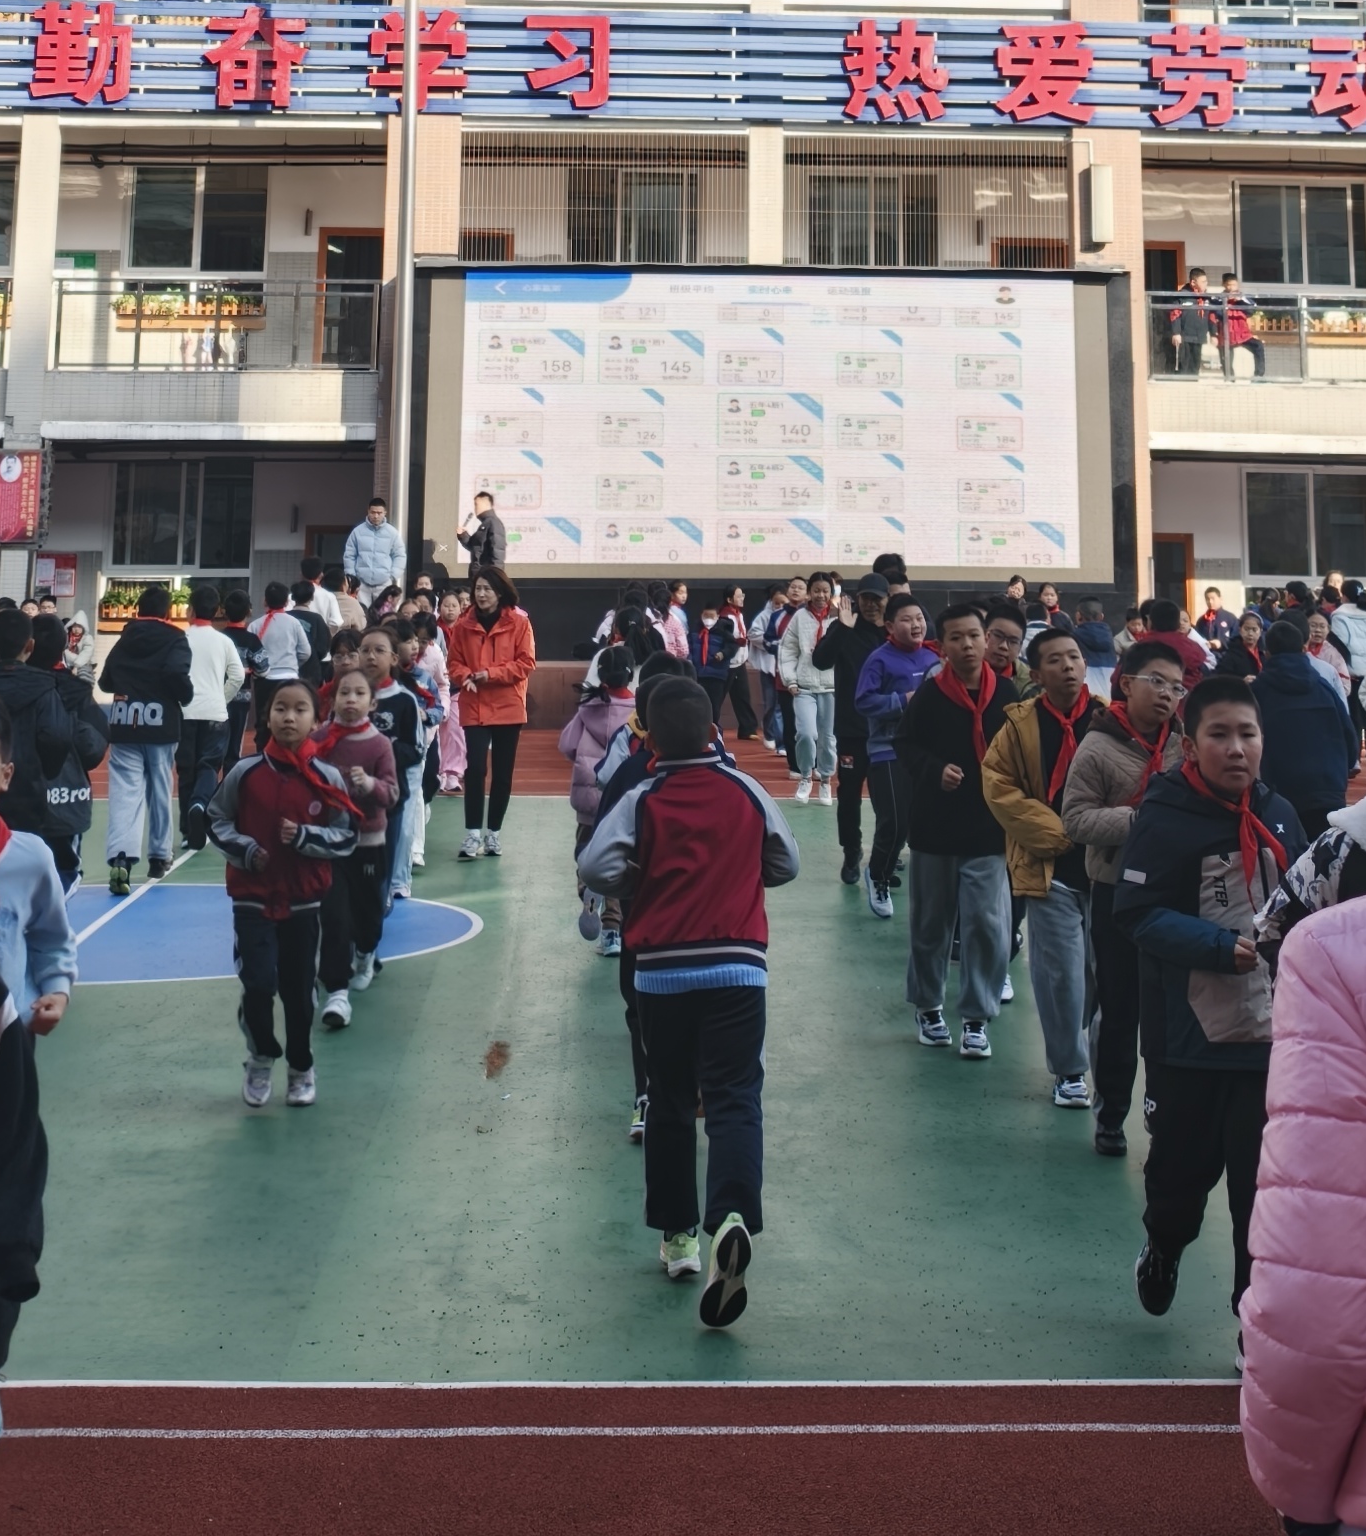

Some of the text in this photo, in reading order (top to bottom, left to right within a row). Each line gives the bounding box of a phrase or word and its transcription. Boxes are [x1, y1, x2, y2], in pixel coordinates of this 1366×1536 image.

[28, 1, 611, 112] 勤奋学习
[541, 360, 573, 373] 158
[661, 360, 692, 373] 145
[779, 424, 811, 437] 140
[779, 487, 811, 499] 154
[1021, 553, 1053, 565] 153
[1213, 875, 1229, 908] XTEP
